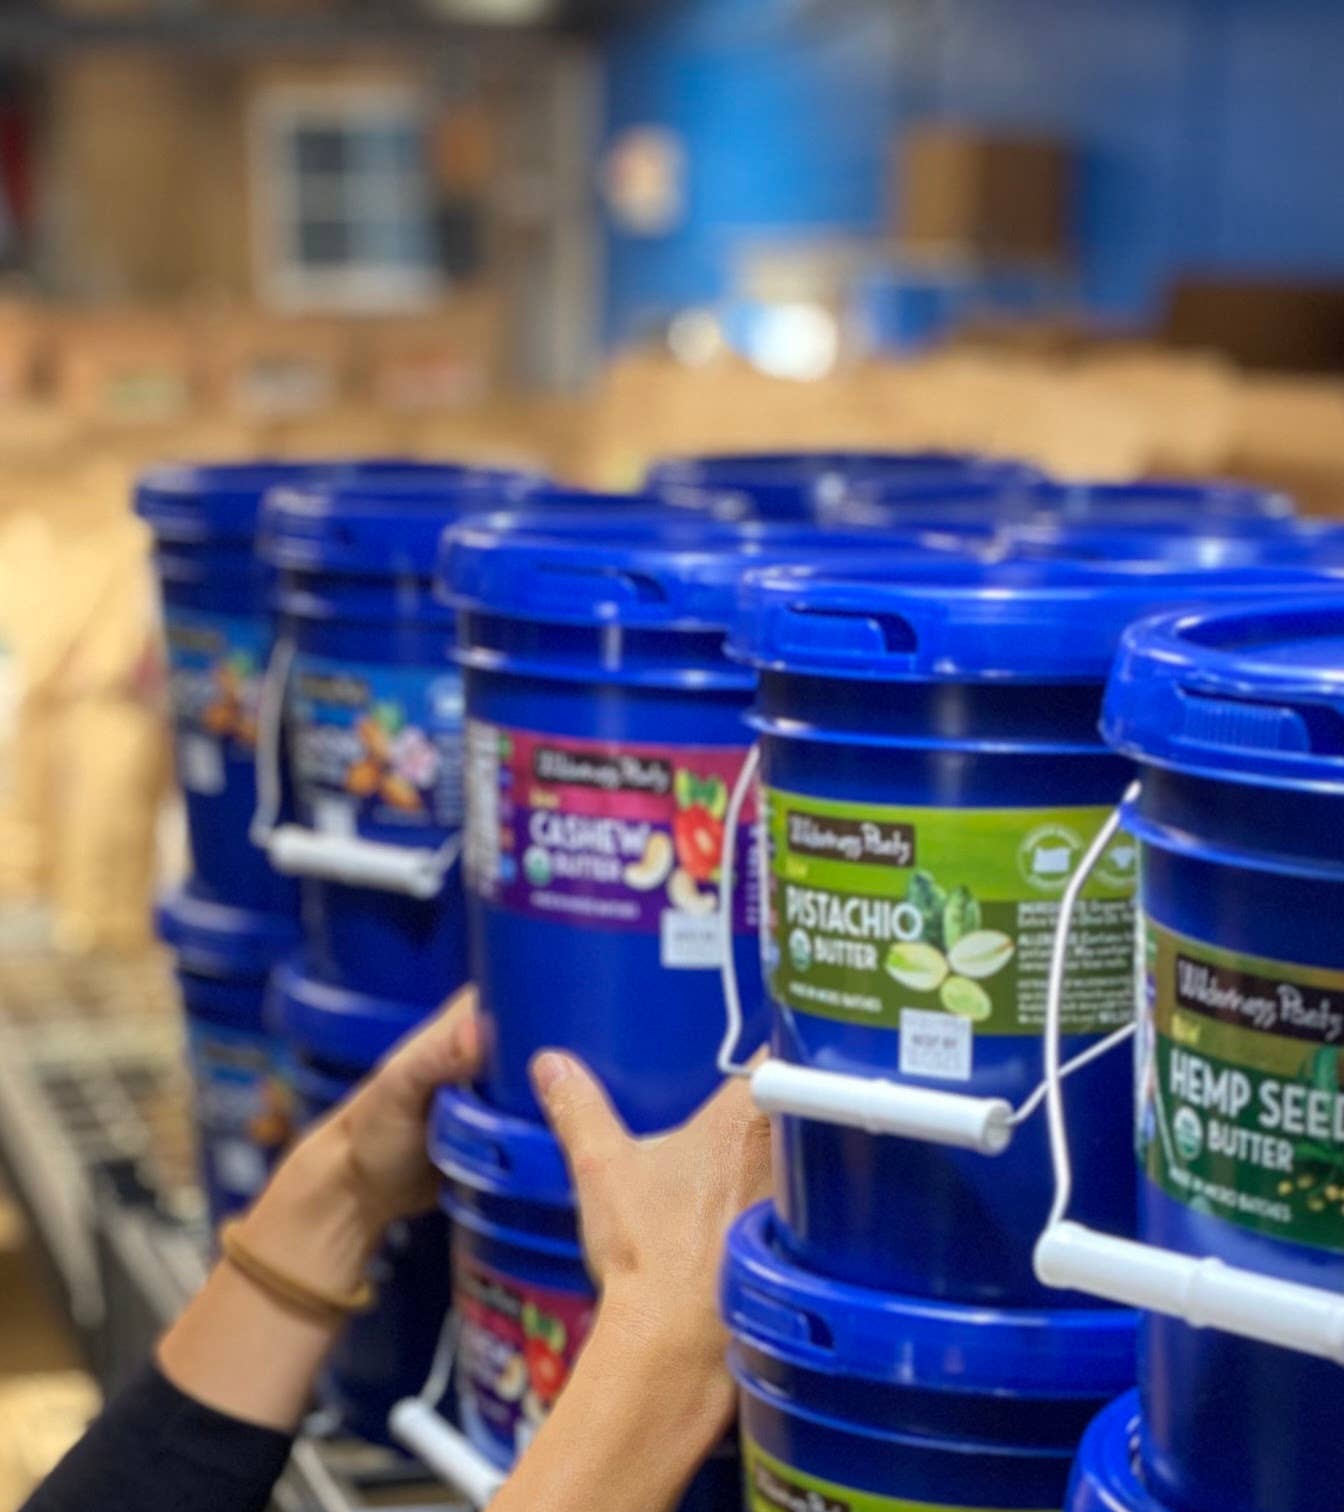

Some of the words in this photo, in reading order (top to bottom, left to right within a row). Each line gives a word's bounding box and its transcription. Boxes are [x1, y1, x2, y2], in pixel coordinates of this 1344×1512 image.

[530, 810, 651, 855] CASHEW
[553, 851, 621, 881] BUTTER
[786, 886, 923, 941] PISTACHIO
[814, 936, 878, 970] BUTTER
[1177, 959, 1278, 1030] Wilderness
[1277, 984, 1344, 1041] Poets
[1170, 1048, 1251, 1118] HEMP
[1208, 1119, 1293, 1173] BUTTER
